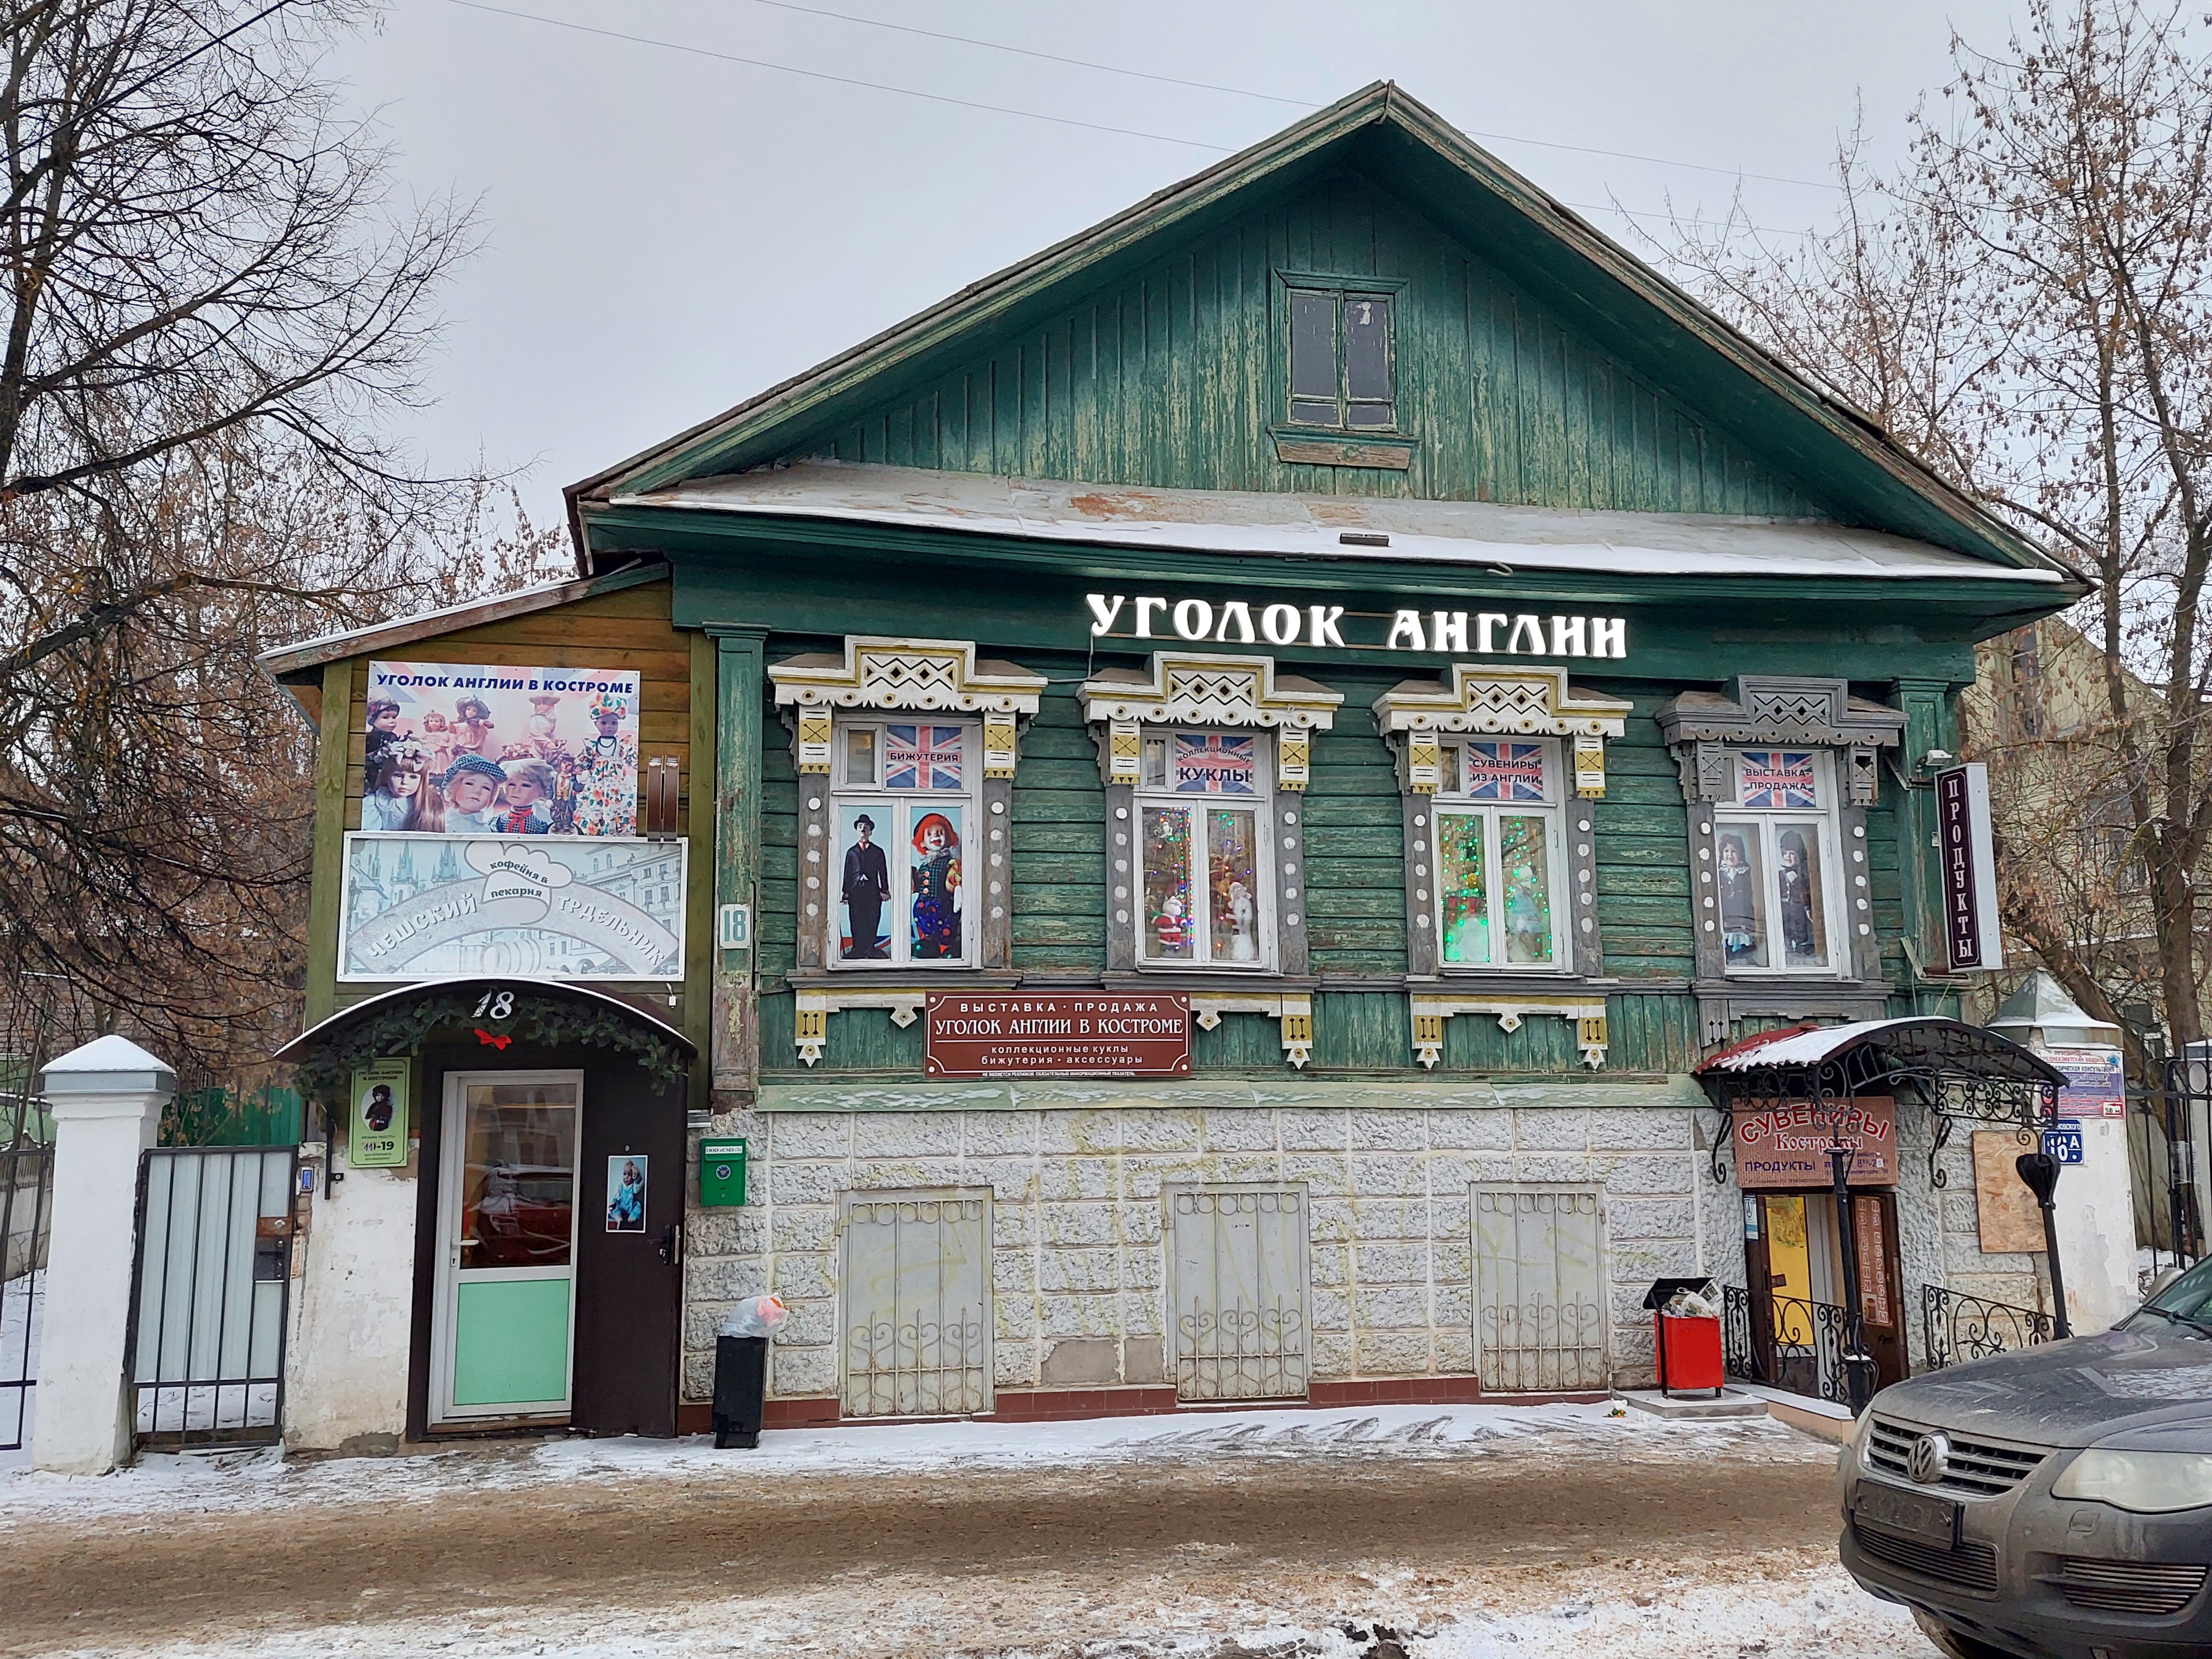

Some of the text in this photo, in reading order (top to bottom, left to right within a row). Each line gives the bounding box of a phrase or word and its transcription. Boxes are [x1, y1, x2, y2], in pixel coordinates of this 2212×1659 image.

[1086, 594, 1626, 658] УГОЛОК АНГЛИИ
[376, 674, 633, 693] УГОЛОК АНГЛИИ В КОСТРОМЕ
[890, 752, 958, 762] БИЖУТЕРИЯ
[1178, 746, 1251, 765] КОЛЛЕКЦИОННЫЕ
[1473, 759, 1538, 770] СУВЕНИРЫ
[1180, 767, 1249, 782] КУКЛЫ
[1491, 774, 1539, 783] АНГЛИИ
[1746, 767, 1810, 777] ВЫСТАВКА-
[1749, 781, 1807, 791] ПРОДАЖА
[489, 859, 539, 881] кофейня
[1947, 778, 1973, 958] ПРОДУКТЫ
[490, 886, 542, 898] пекарня
[365, 892, 665, 965] ЧЕШСКИЙ ТРДЕЛЬНИК
[724, 910, 746, 941] 18
[470, 989, 515, 1019] 18
[961, 1003, 1158, 1013] ВЫСТАВКА ПРОДАЖА
[935, 1019, 1183, 1035] УГОЛОК АНГЛИИ В КОСТРОМЕ
[992, 1046, 1128, 1055] коллекционные куклы
[982, 1055, 1142, 1065] бижутерия аксессуары
[1740, 1102, 1890, 1143] СУВЕНИРЫ
[2069, 1135, 2080, 1148] А
[1745, 1161, 1815, 1172] ПРОДУКТЫ
